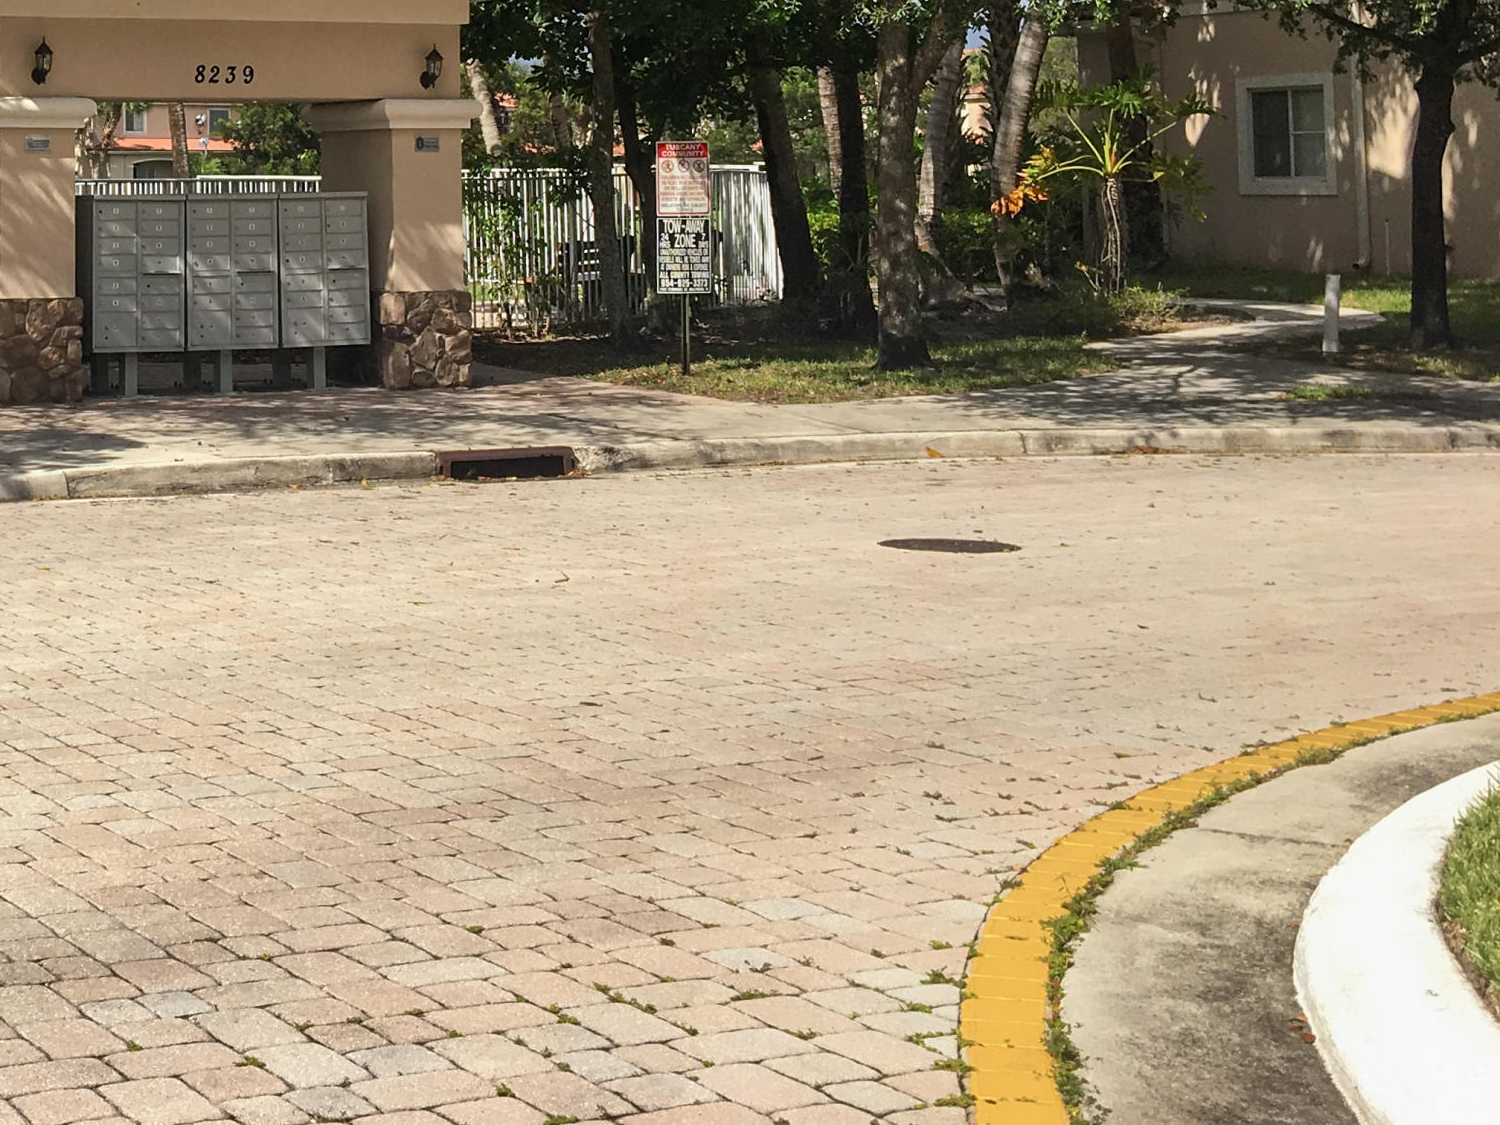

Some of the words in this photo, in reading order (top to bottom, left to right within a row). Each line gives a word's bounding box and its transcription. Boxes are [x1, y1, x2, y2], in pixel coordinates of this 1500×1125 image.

[194, 64, 254, 85] 8239
[665, 143, 701, 151] TUSCANY
[662, 219, 705, 234] TOW-AWAY
[674, 233, 696, 248] ZONE
